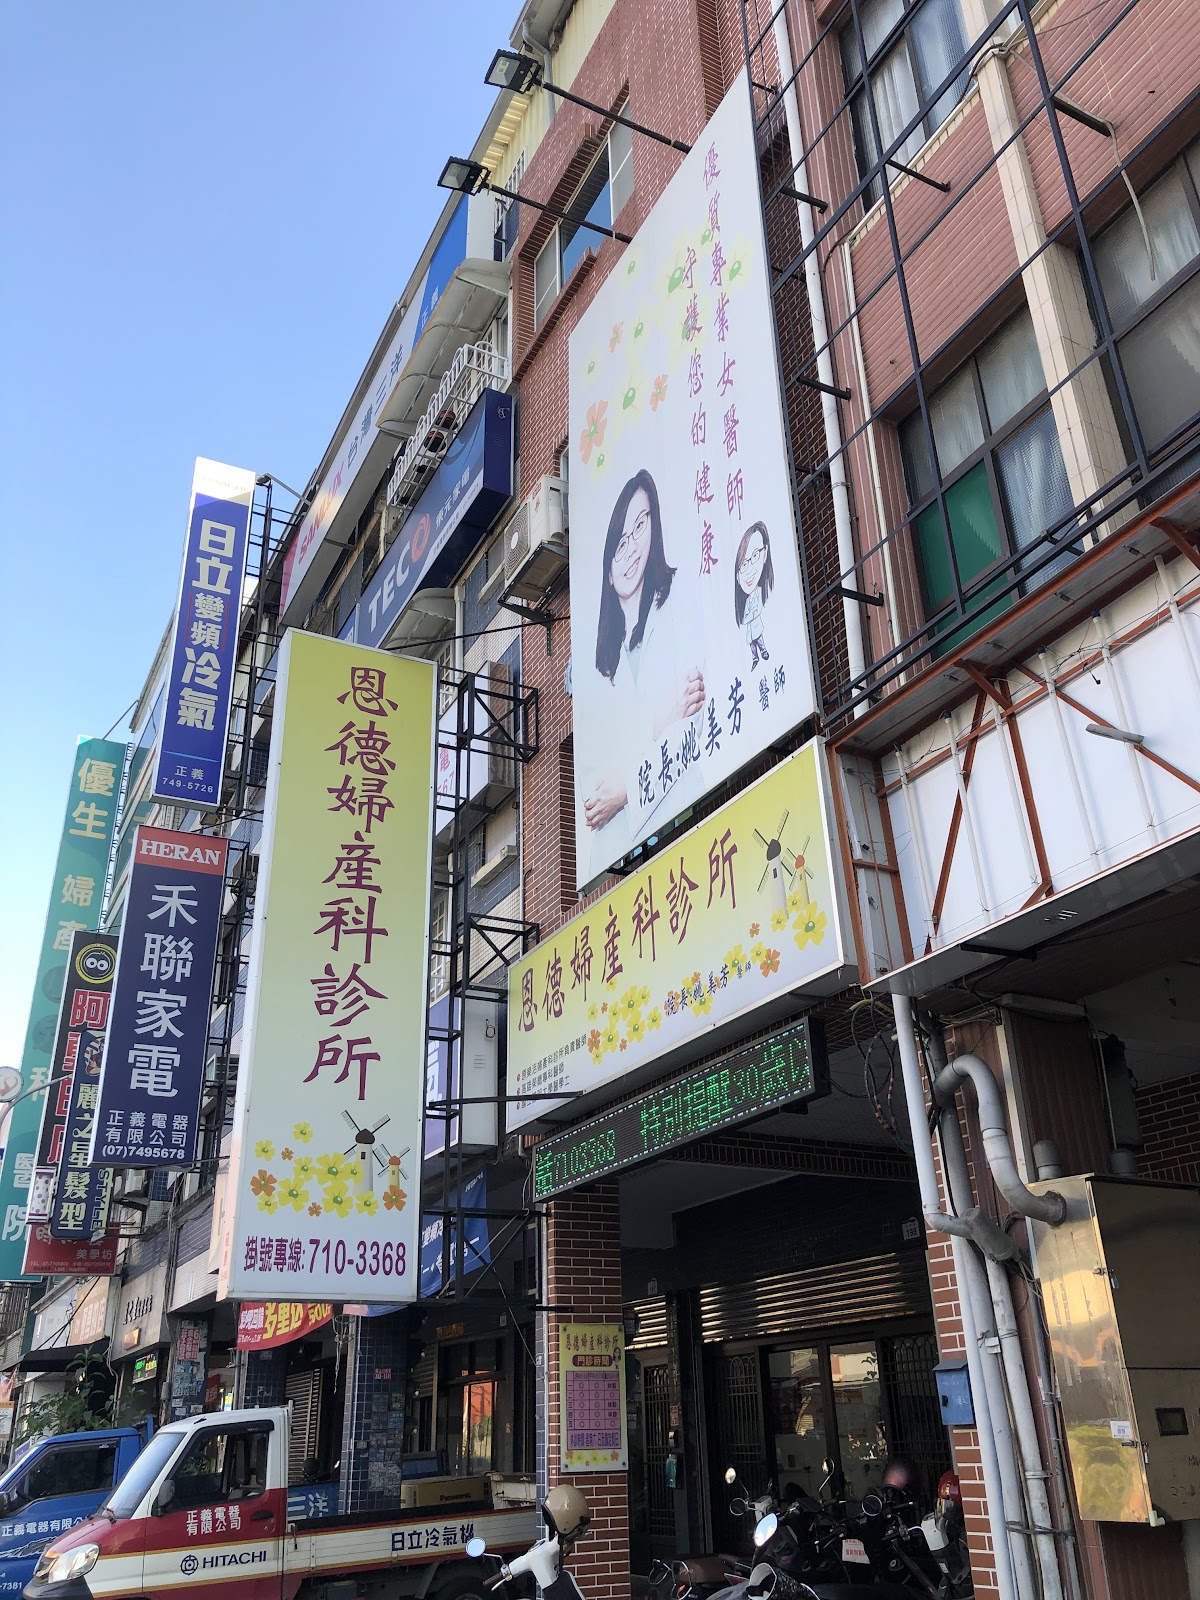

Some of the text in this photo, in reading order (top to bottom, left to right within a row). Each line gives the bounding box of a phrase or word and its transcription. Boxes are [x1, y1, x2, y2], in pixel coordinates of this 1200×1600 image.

[702, 141, 744, 521] 優質專業女醫師
[681, 246, 719, 575] 守護您的健康
[368, 513, 431, 633] TECO
[176, 518, 237, 732] 日立變頻冷氣
[758, 664, 786, 712] 醫師
[174, 764, 205, 782] 正義
[161, 776, 215, 794] 749-5726
[138, 838, 222, 867] HERAN
[127, 883, 199, 1099] 禾聯家電
[105, 1109, 190, 1131] 正義電器
[105, 1127, 189, 1149] 有限公司
[101, 1144, 186, 1161] (07)7495678
[439, 1491, 471, 1502] Panasonic
[186, 1505, 240, 1523] 正義電器
[186, 1518, 241, 1537] 有限公司
[391, 1523, 475, 1552] 日立冷氣機
[202, 1550, 267, 1569] HITACHI
